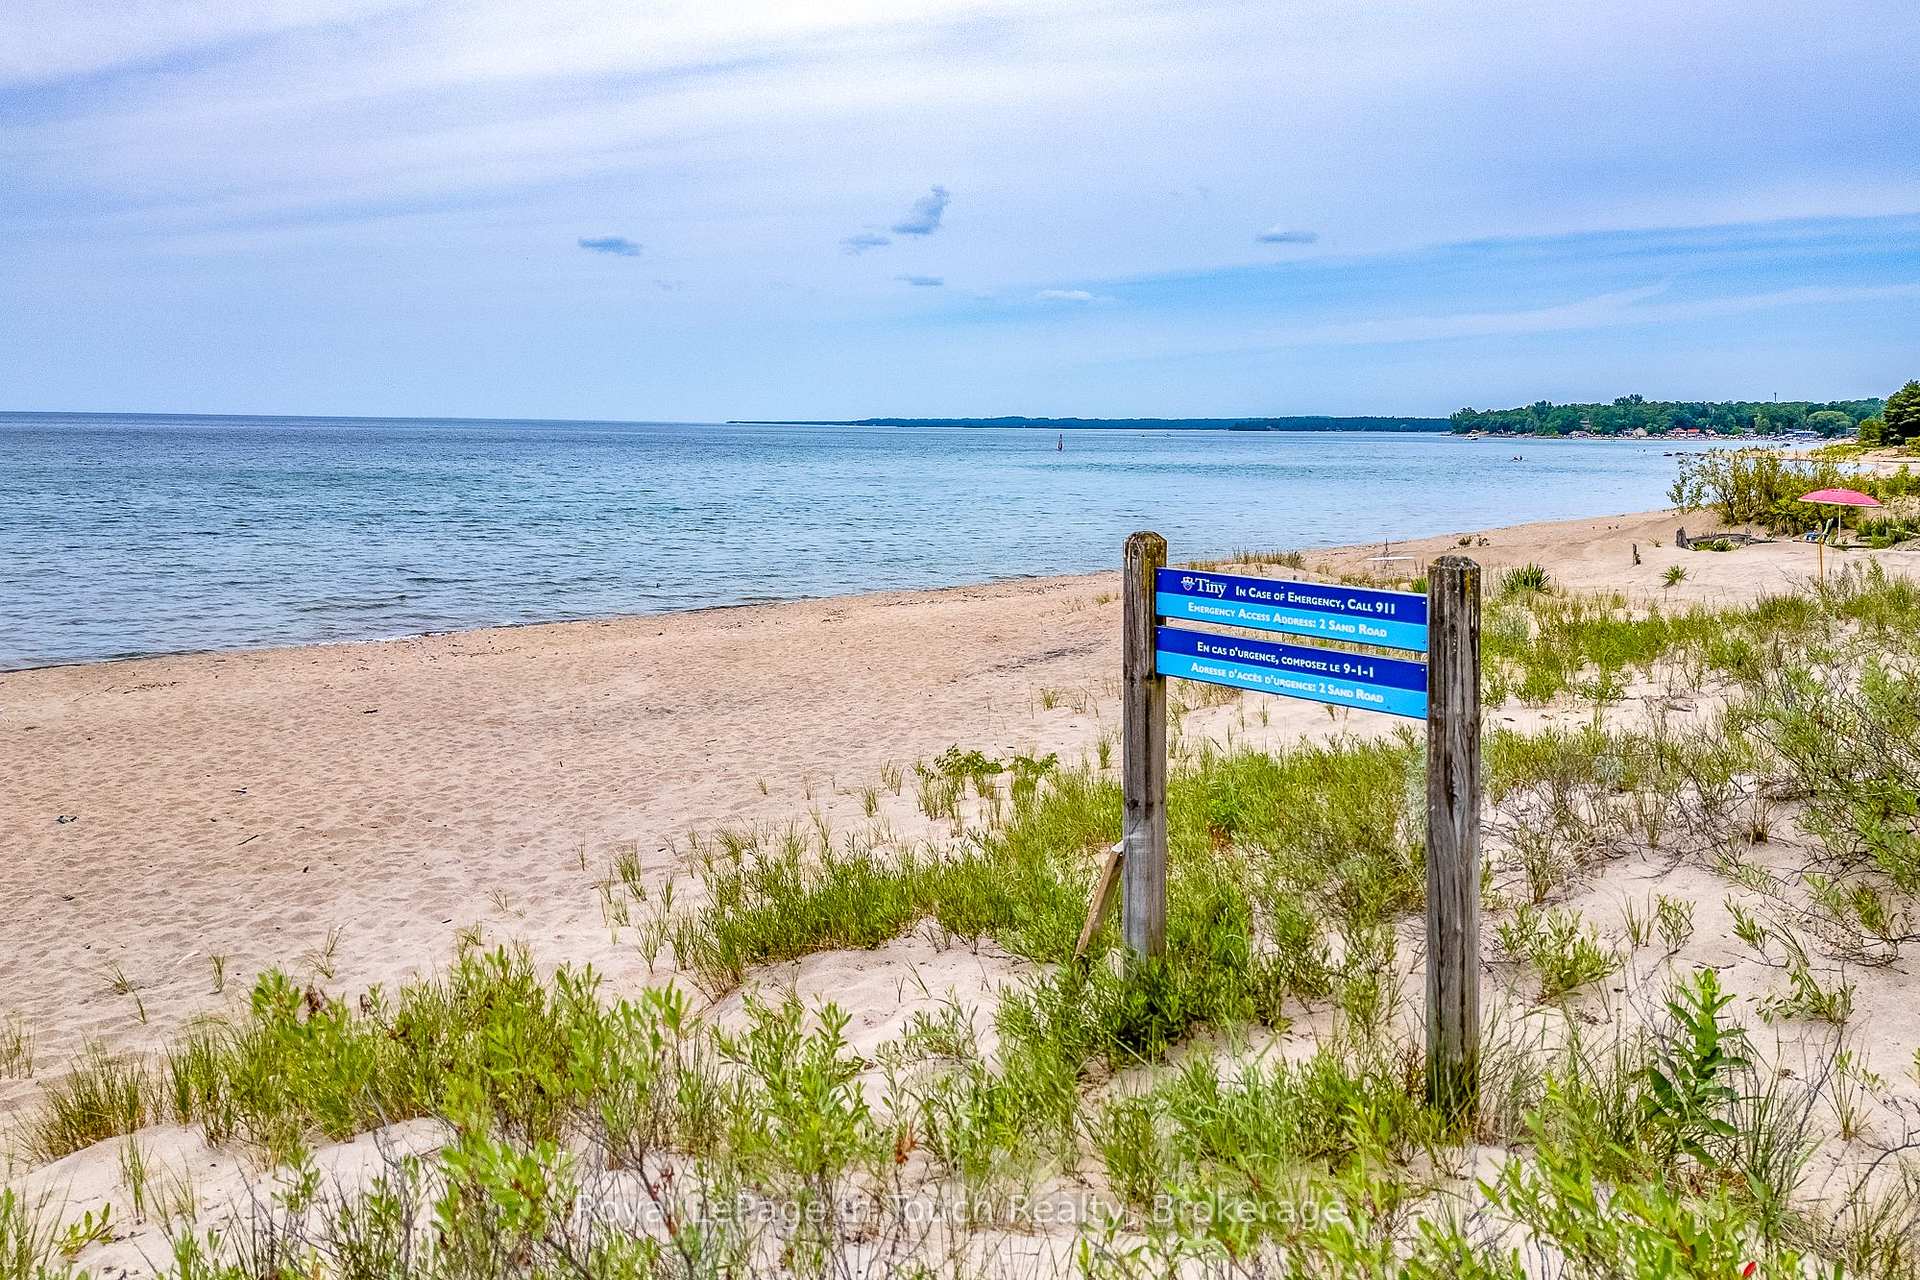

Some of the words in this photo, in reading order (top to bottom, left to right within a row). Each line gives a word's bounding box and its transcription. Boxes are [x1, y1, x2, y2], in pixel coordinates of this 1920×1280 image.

[1195, 577, 1227, 598] Tiny
[1375, 602, 1395, 615] 911
[1319, 618, 1326, 629] 2
[1343, 663, 1374, 678] 9-1-1
[1318, 683, 1326, 694] 2
